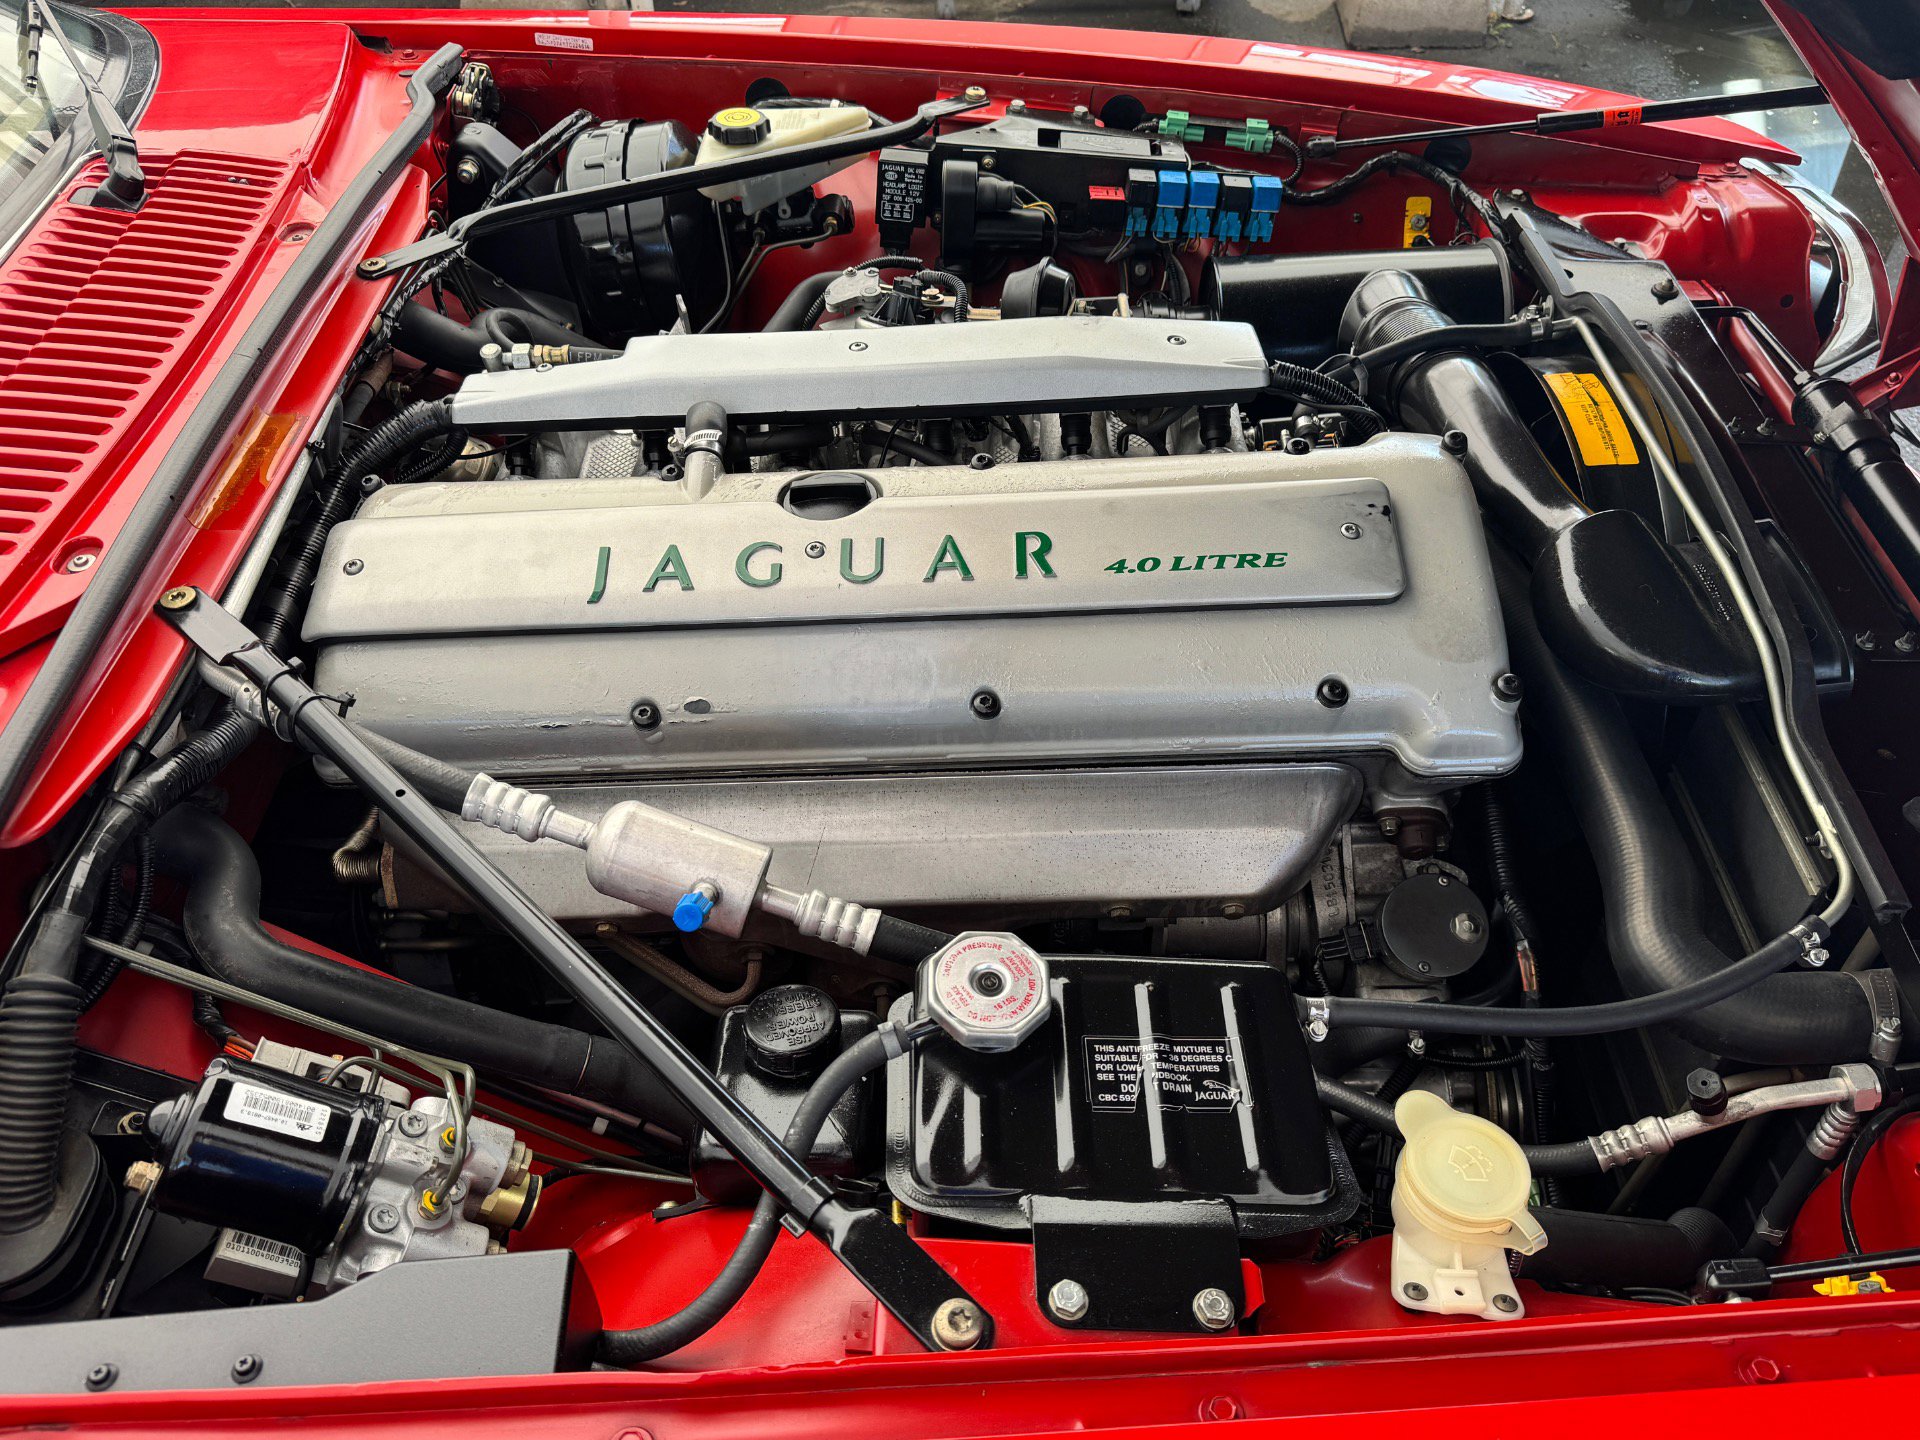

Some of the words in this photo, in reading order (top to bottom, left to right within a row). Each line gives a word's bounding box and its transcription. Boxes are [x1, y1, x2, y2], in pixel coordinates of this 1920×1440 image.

[586, 530, 1058, 604] JAGUAR
[1104, 557, 1161, 574] 4.0
[1168, 552, 1288, 571] LITRE
[962, 942, 1003, 952] PRESSURE
[1018, 992, 1034, 1012] WHEN
[1028, 978, 1036, 991] HOT
[994, 1002, 1003, 1011] 16
[767, 1012, 816, 1032] POWER
[765, 1020, 825, 1041] APPROVED
[787, 1034, 811, 1046] USE
[1116, 1043, 1170, 1052] ANTIFREEZE
[1142, 1053, 1158, 1061] FOR
[1151, 1062, 1220, 1072] TEMPERATURES
[1152, 1072, 1191, 1081] NDBOOK.
[1121, 1084, 1136, 1092] DO
[1162, 1082, 1192, 1093] DRAIN
[1195, 1091, 1235, 1101] JAGUAR
